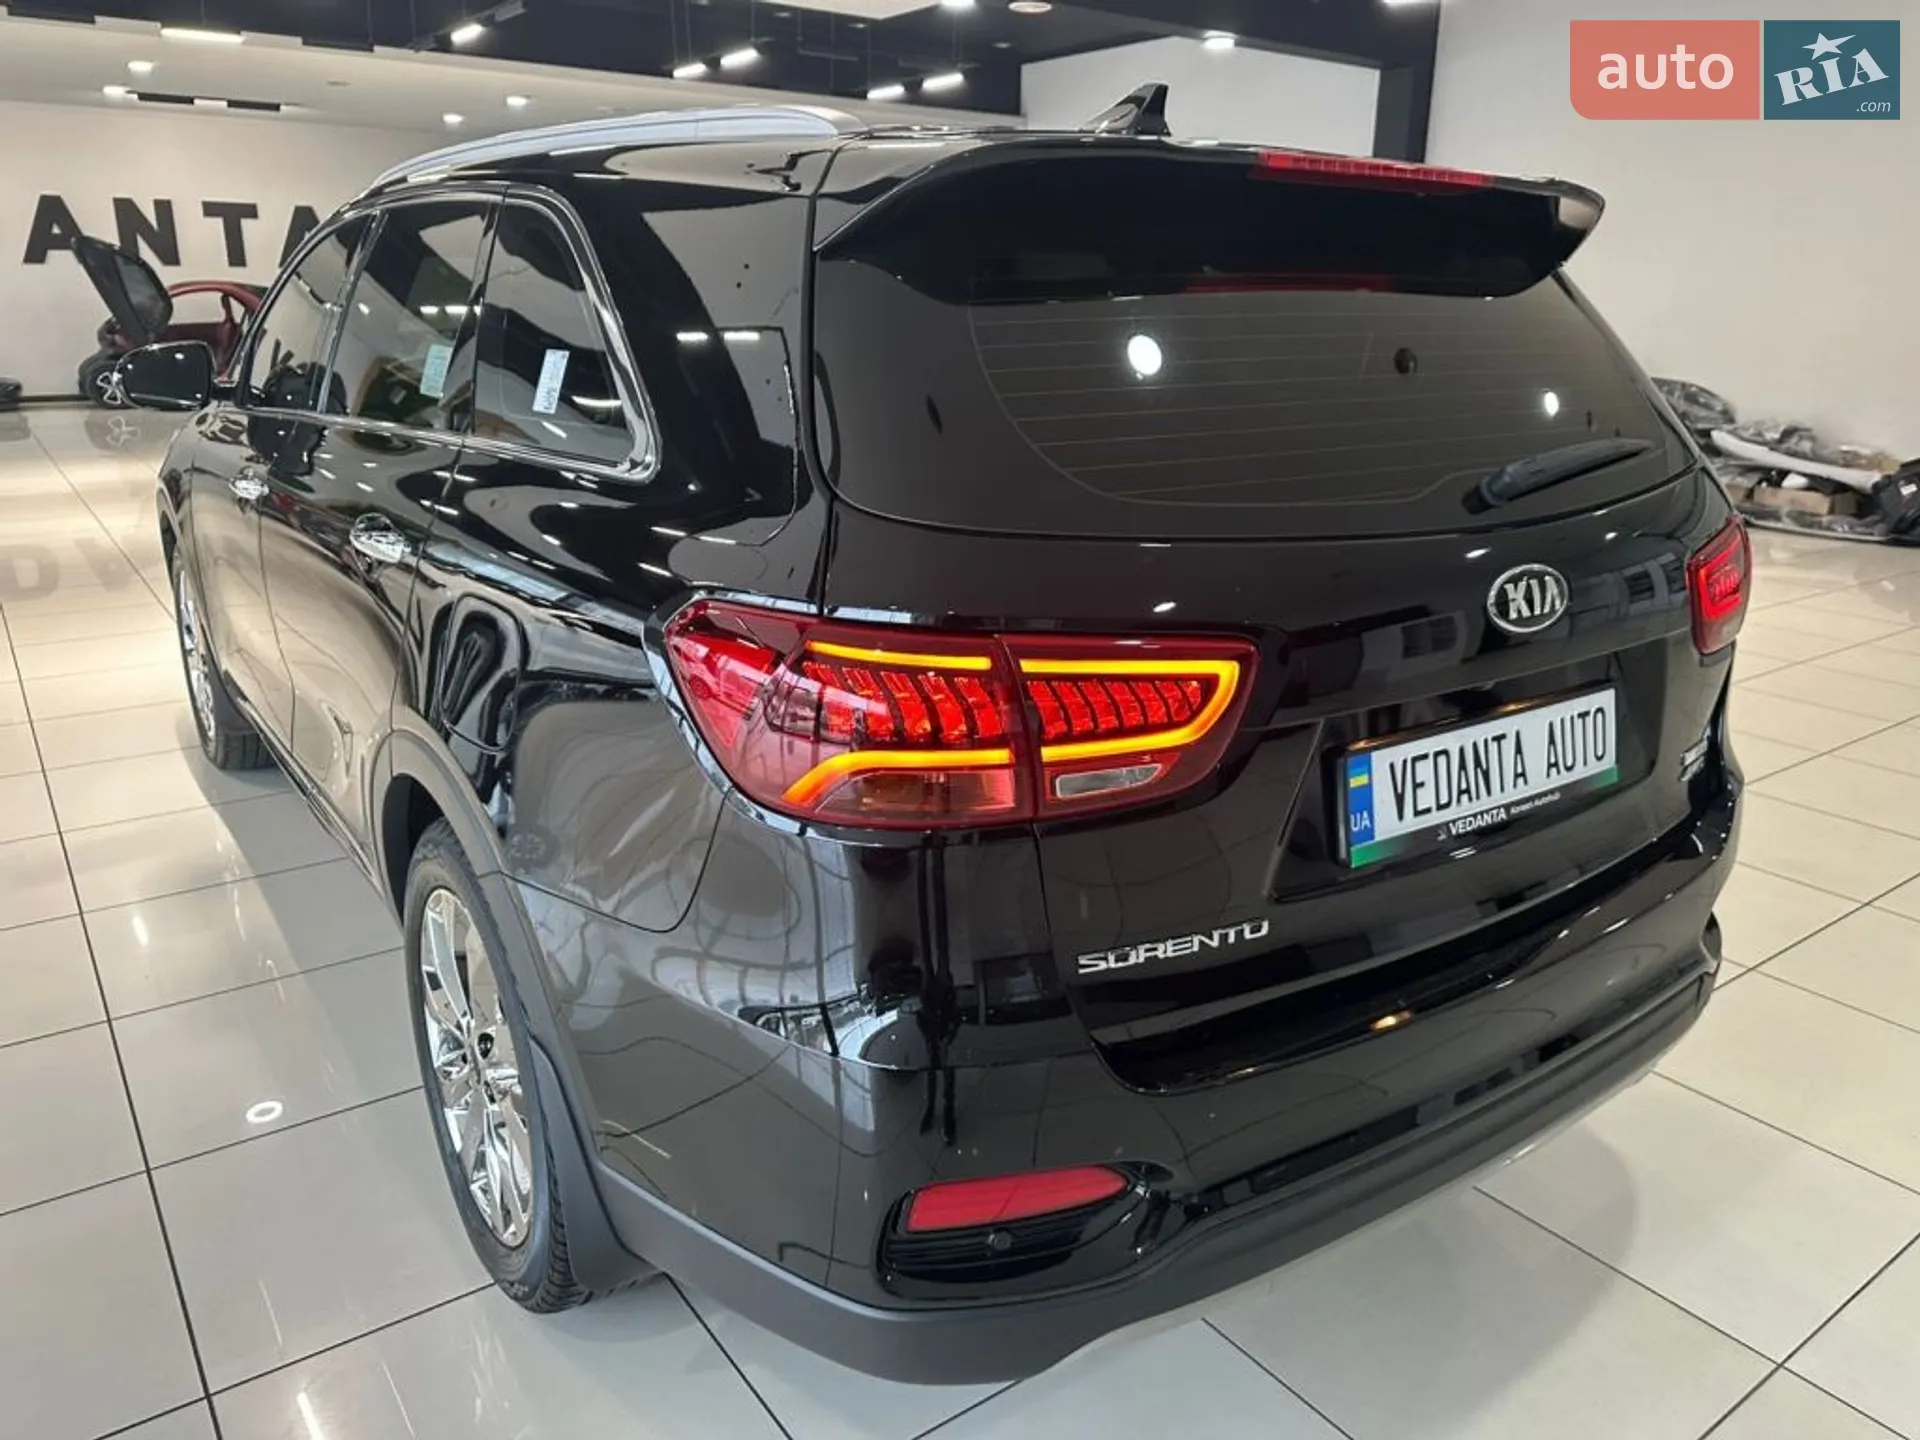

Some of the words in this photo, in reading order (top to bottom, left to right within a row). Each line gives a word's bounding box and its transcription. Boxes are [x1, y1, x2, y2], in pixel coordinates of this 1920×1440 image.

[1503, 575, 1562, 620] KIA
[1388, 729, 1530, 822] VEDANTA
[1546, 706, 1608, 780] AUTO
[1350, 813, 1373, 833] UA
[1448, 806, 1508, 836] VEDANTA
[1077, 918, 1270, 975] SORENTO
